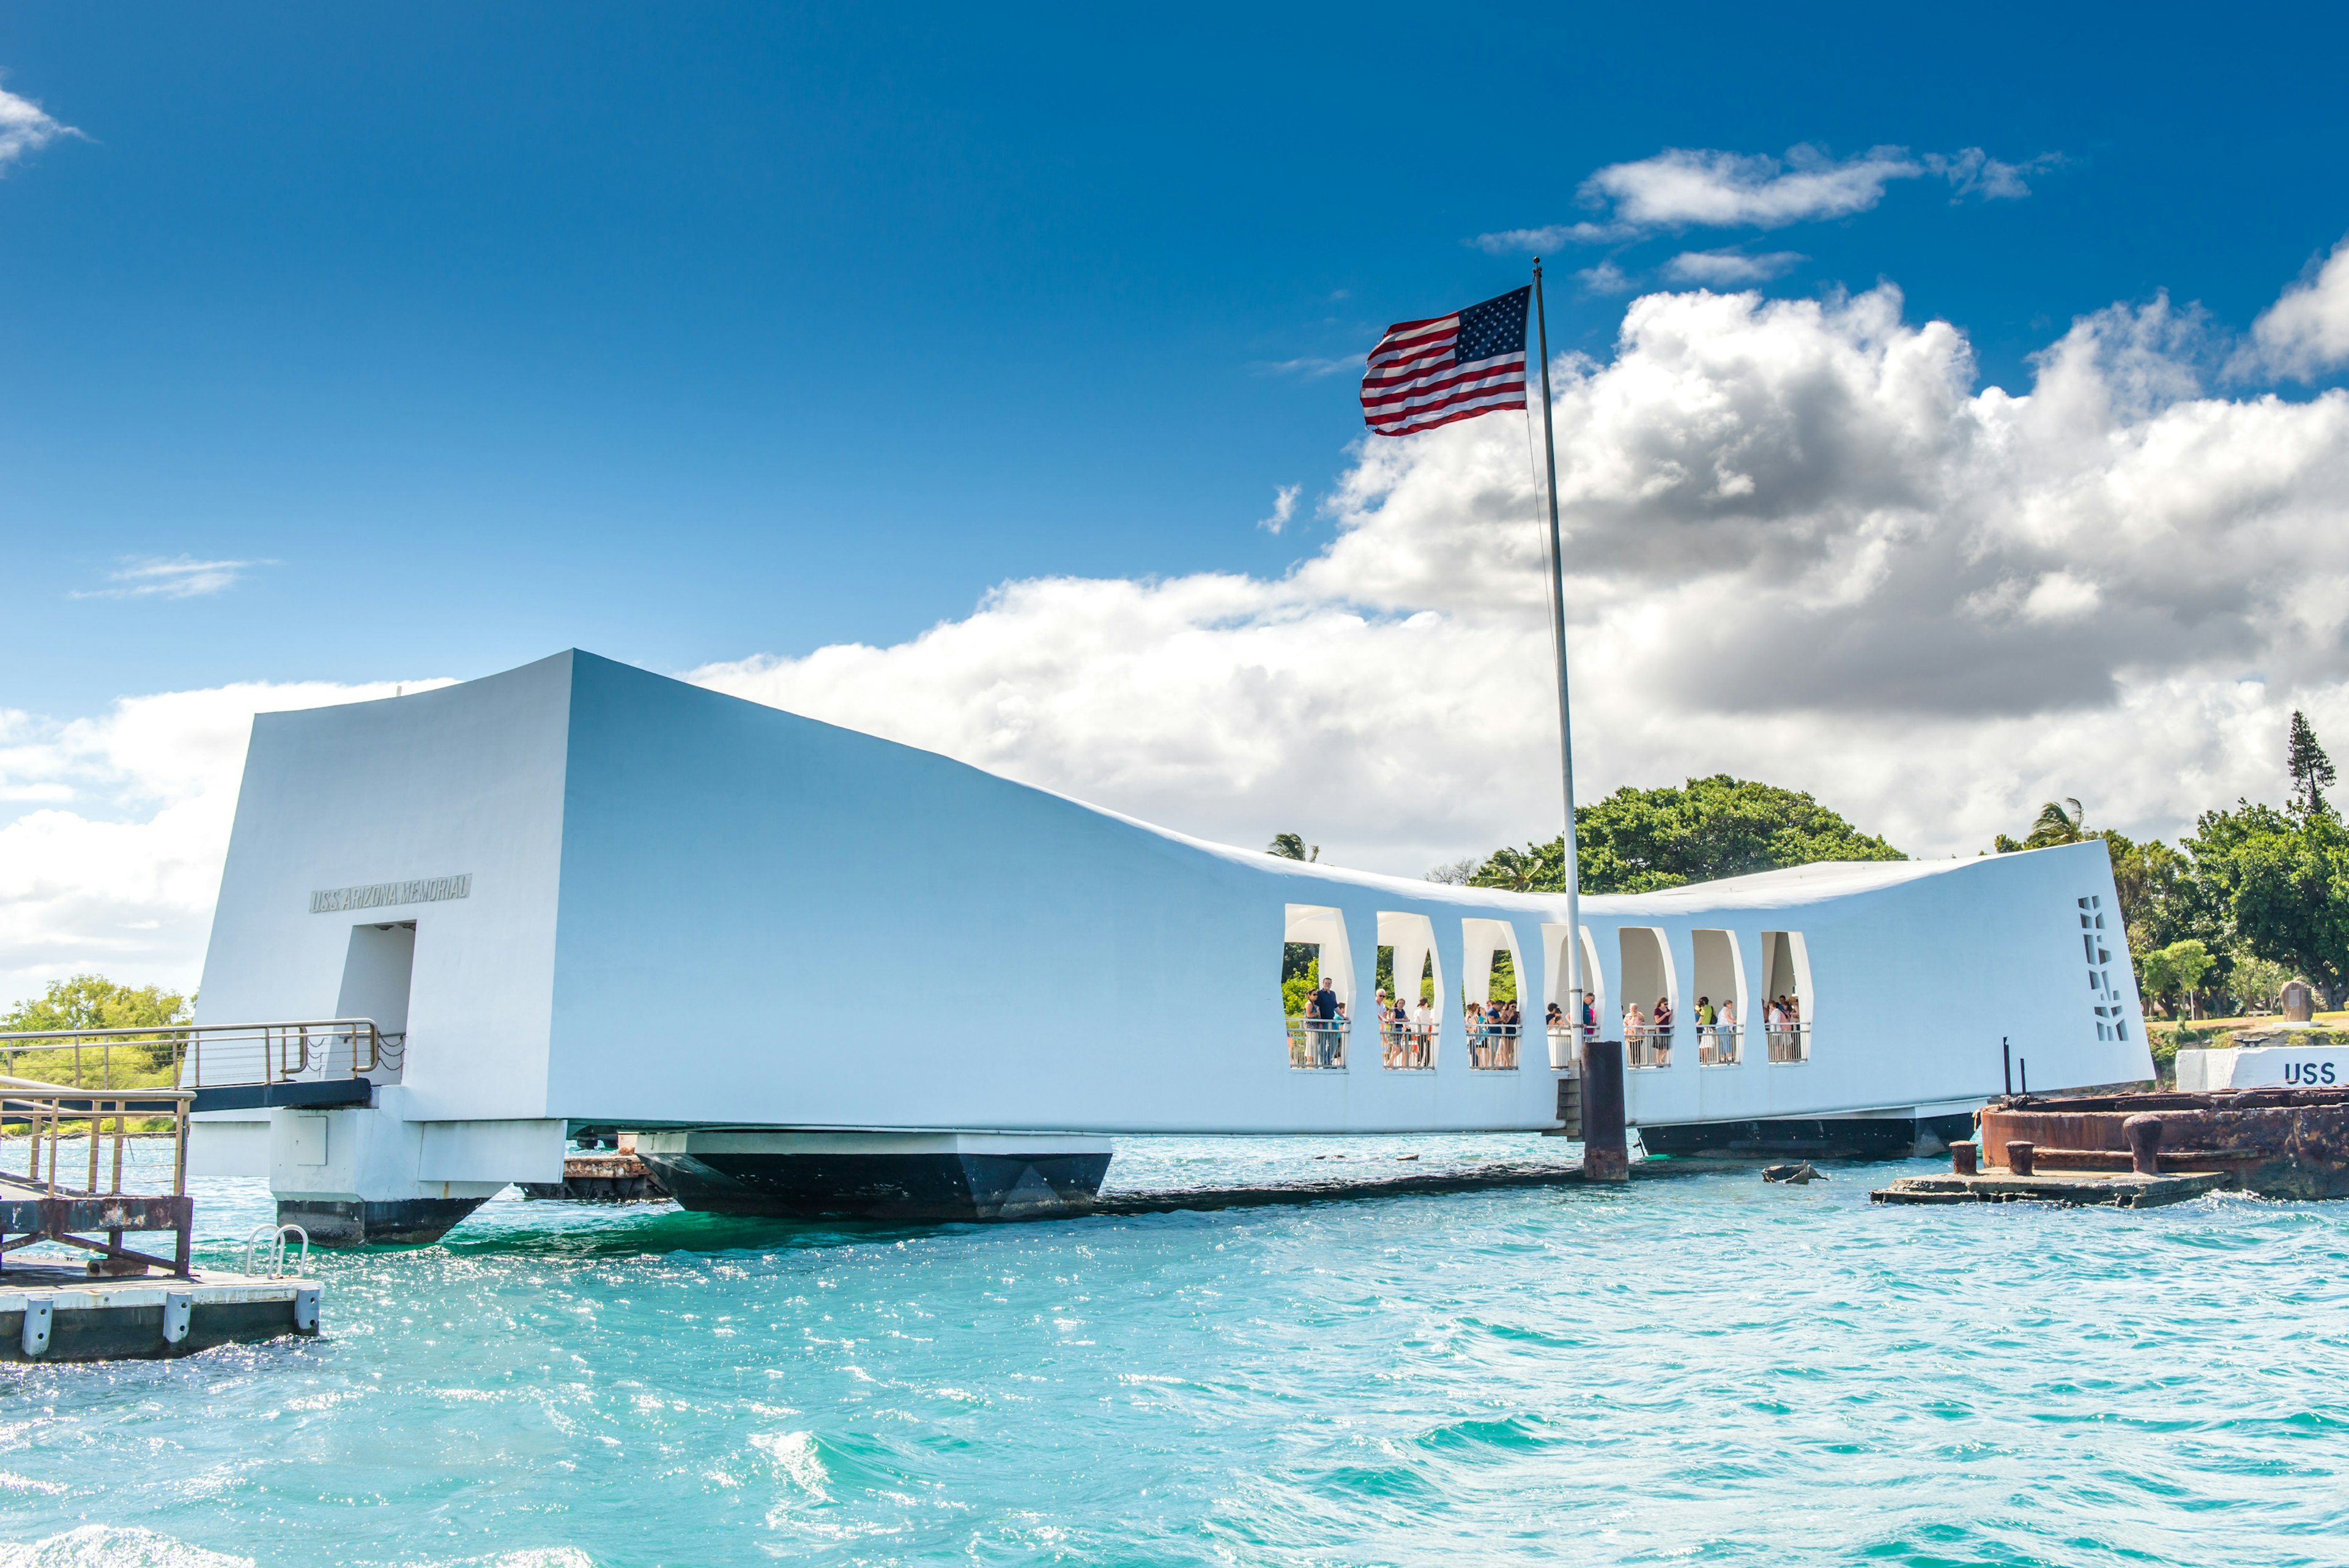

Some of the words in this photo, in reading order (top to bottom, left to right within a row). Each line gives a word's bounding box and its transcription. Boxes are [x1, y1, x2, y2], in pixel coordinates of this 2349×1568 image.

[342, 884, 397, 910] ARIZONA
[399, 875, 467, 904] MEMORIAL
[2285, 1062, 2336, 1085] USS
